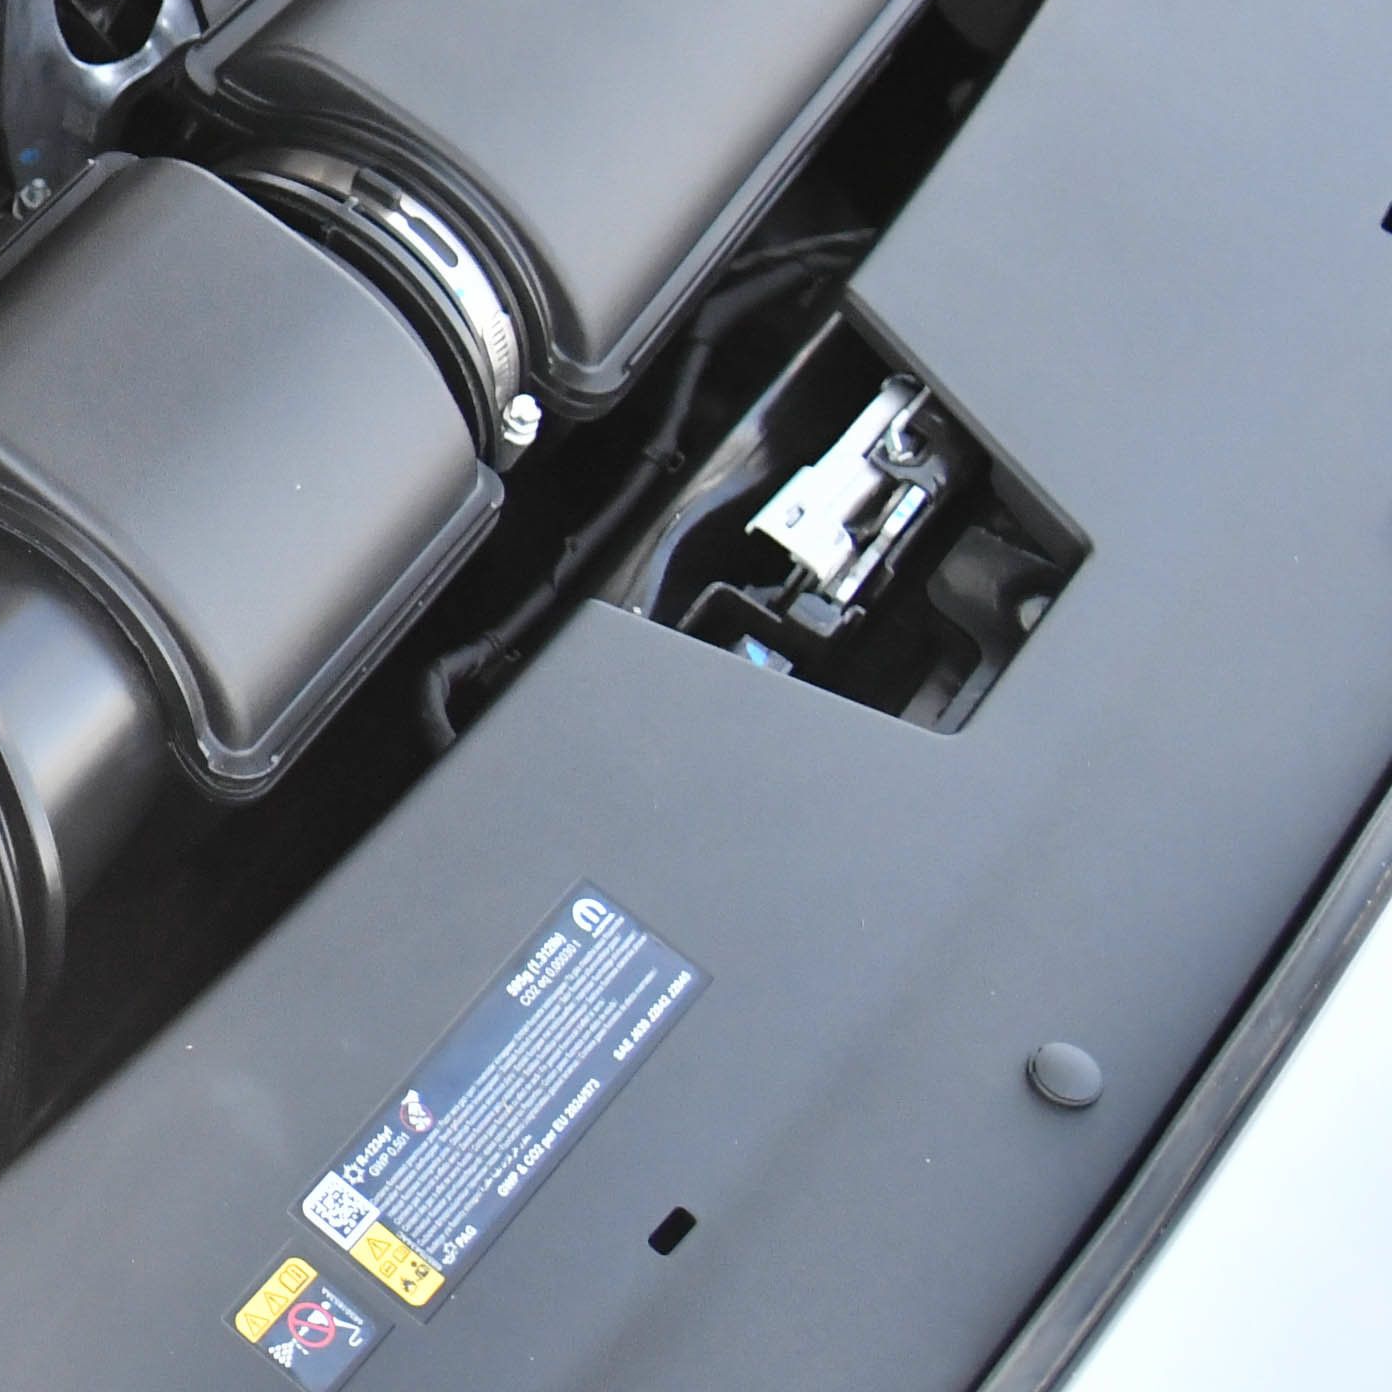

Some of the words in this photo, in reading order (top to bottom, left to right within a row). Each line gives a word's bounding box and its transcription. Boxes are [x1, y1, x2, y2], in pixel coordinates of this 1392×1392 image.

[519, 983, 541, 1006] CO2
[368, 1151, 389, 1176] GWP
[386, 1131, 410, 1156] 0.501
[496, 1170, 519, 1197] GWP
[522, 1142, 545, 1166] CO2
[540, 1128, 557, 1149] per
[551, 1114, 569, 1132] EU
